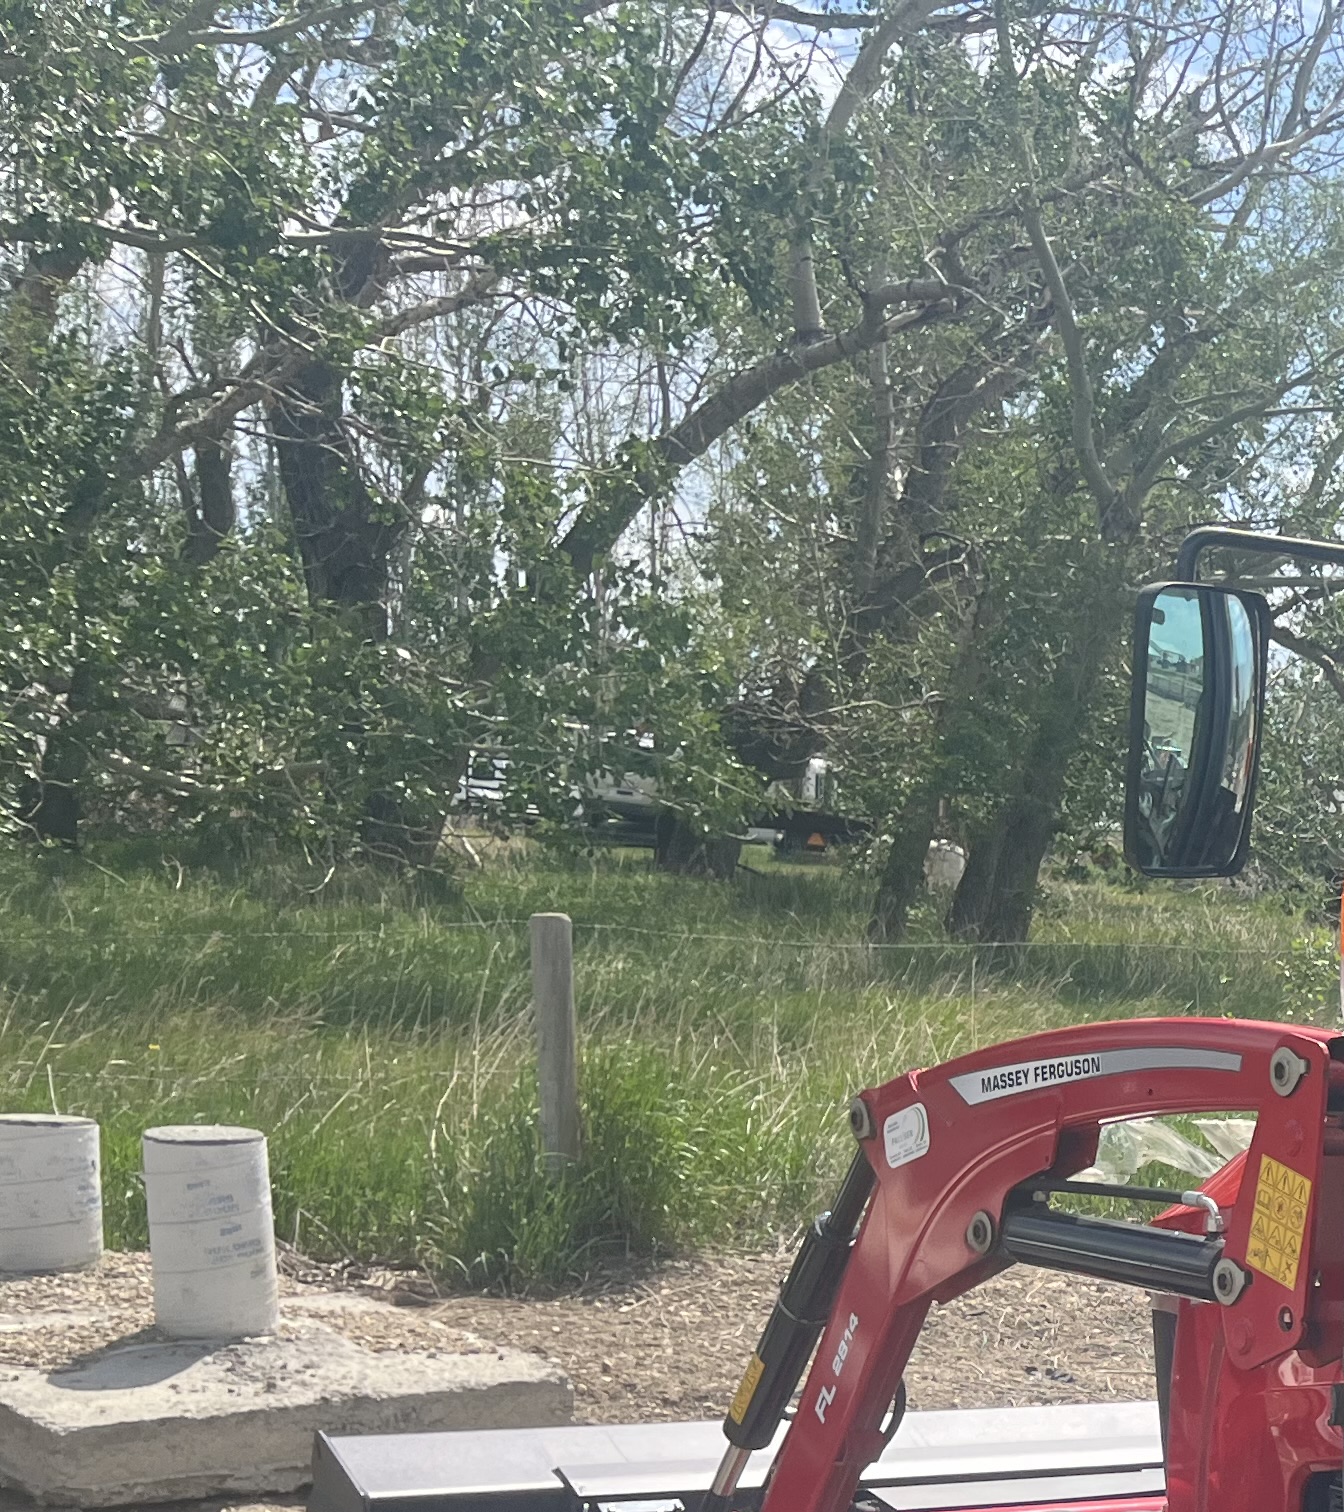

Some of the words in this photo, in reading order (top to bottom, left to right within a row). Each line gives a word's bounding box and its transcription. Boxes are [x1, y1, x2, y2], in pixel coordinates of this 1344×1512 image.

[981, 1068, 1030, 1093] MASSEY
[1034, 1056, 1101, 1083] FERGUSON
[814, 1384, 837, 1424] FL
[832, 1312, 859, 1377] 2814
